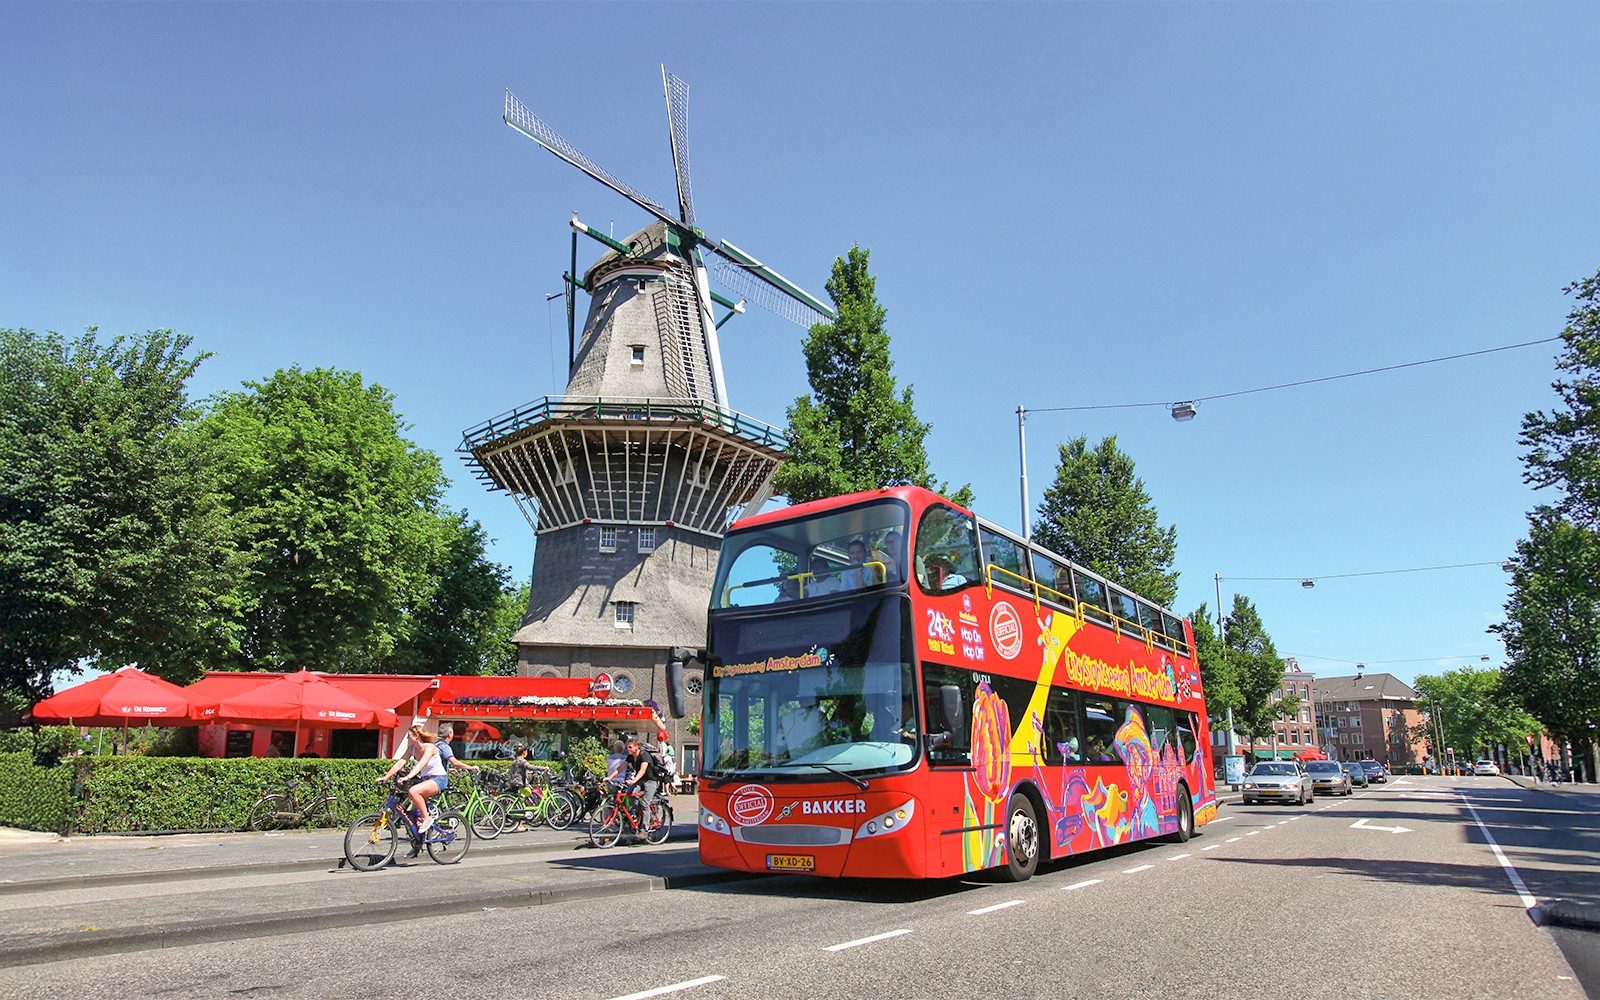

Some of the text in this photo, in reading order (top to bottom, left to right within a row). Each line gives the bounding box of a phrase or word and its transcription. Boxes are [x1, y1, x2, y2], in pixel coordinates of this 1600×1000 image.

[960, 626, 973, 643] Hop
[963, 644, 975, 660] Hop
[766, 653, 821, 671] Amsterdam
[735, 799, 765, 811] OFFICIAL
[802, 800, 866, 814] BAKKER
[773, 857, 812, 867] BV-XD-26
